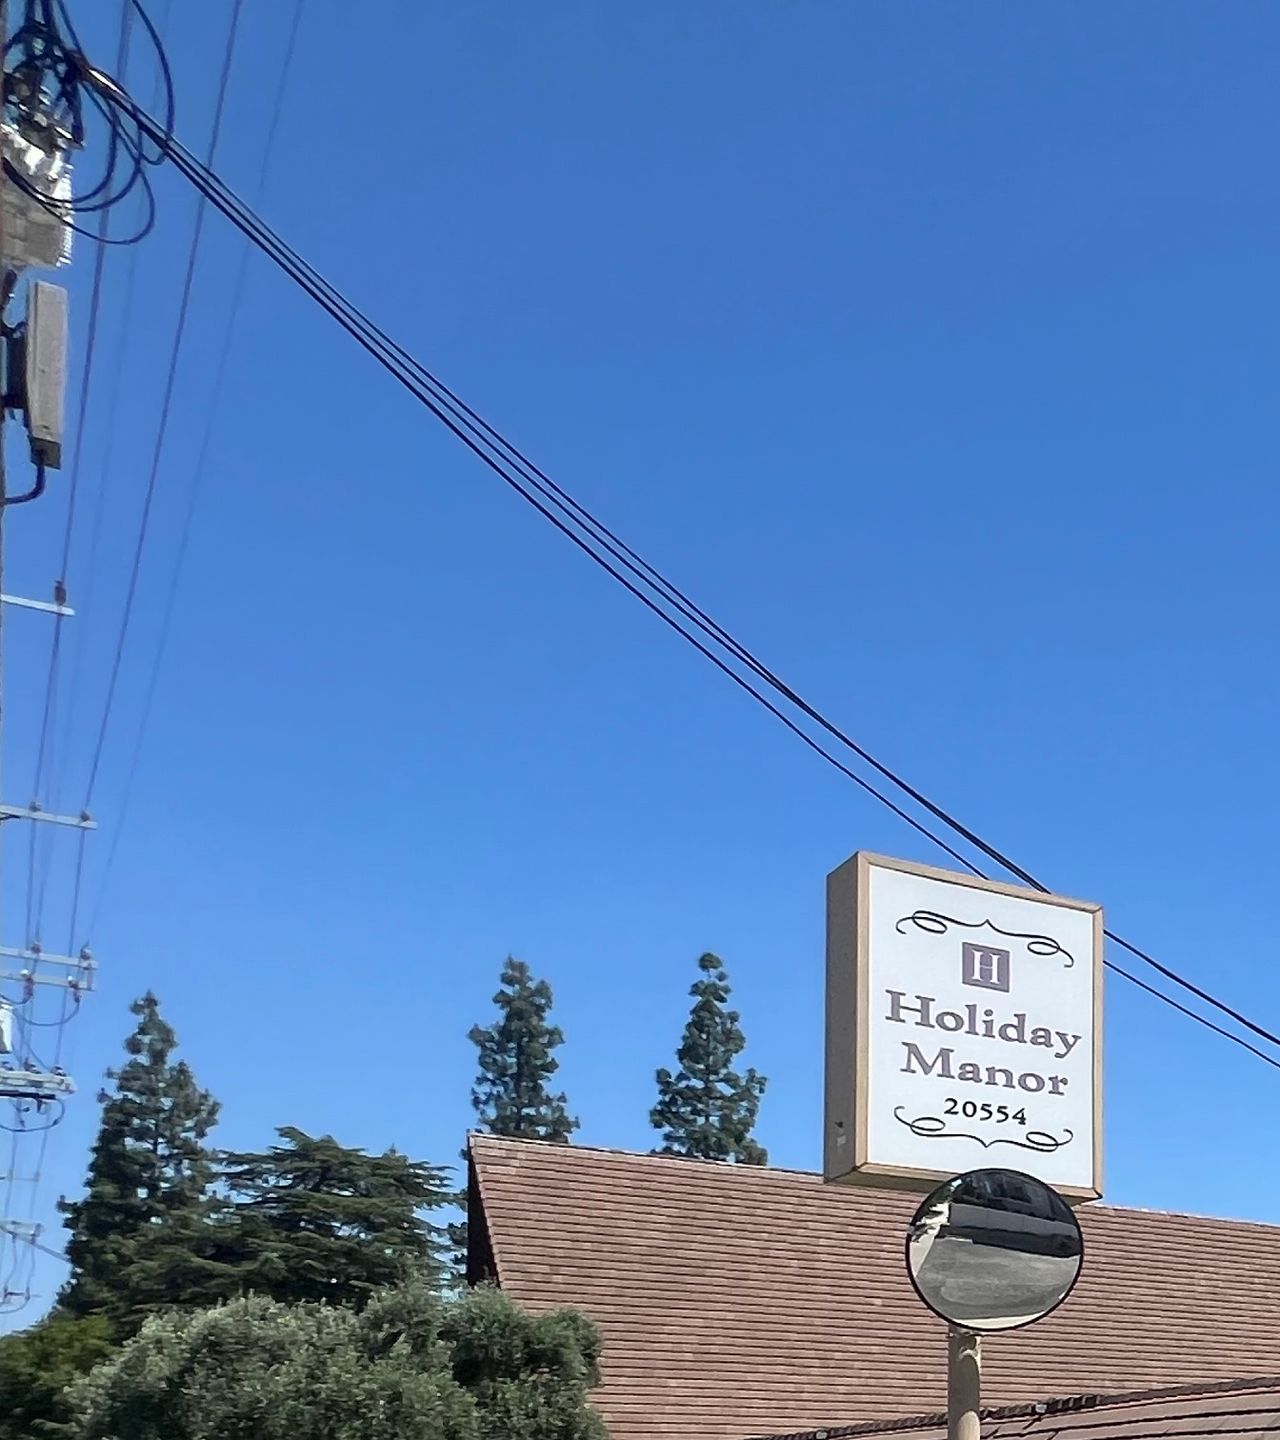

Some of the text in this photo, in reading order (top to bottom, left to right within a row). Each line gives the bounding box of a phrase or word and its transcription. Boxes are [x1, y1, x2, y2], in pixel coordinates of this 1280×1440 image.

[884, 989, 1083, 1059] Holiday
[899, 1041, 1069, 1096] Manor
[943, 1097, 1027, 1126] 20554
